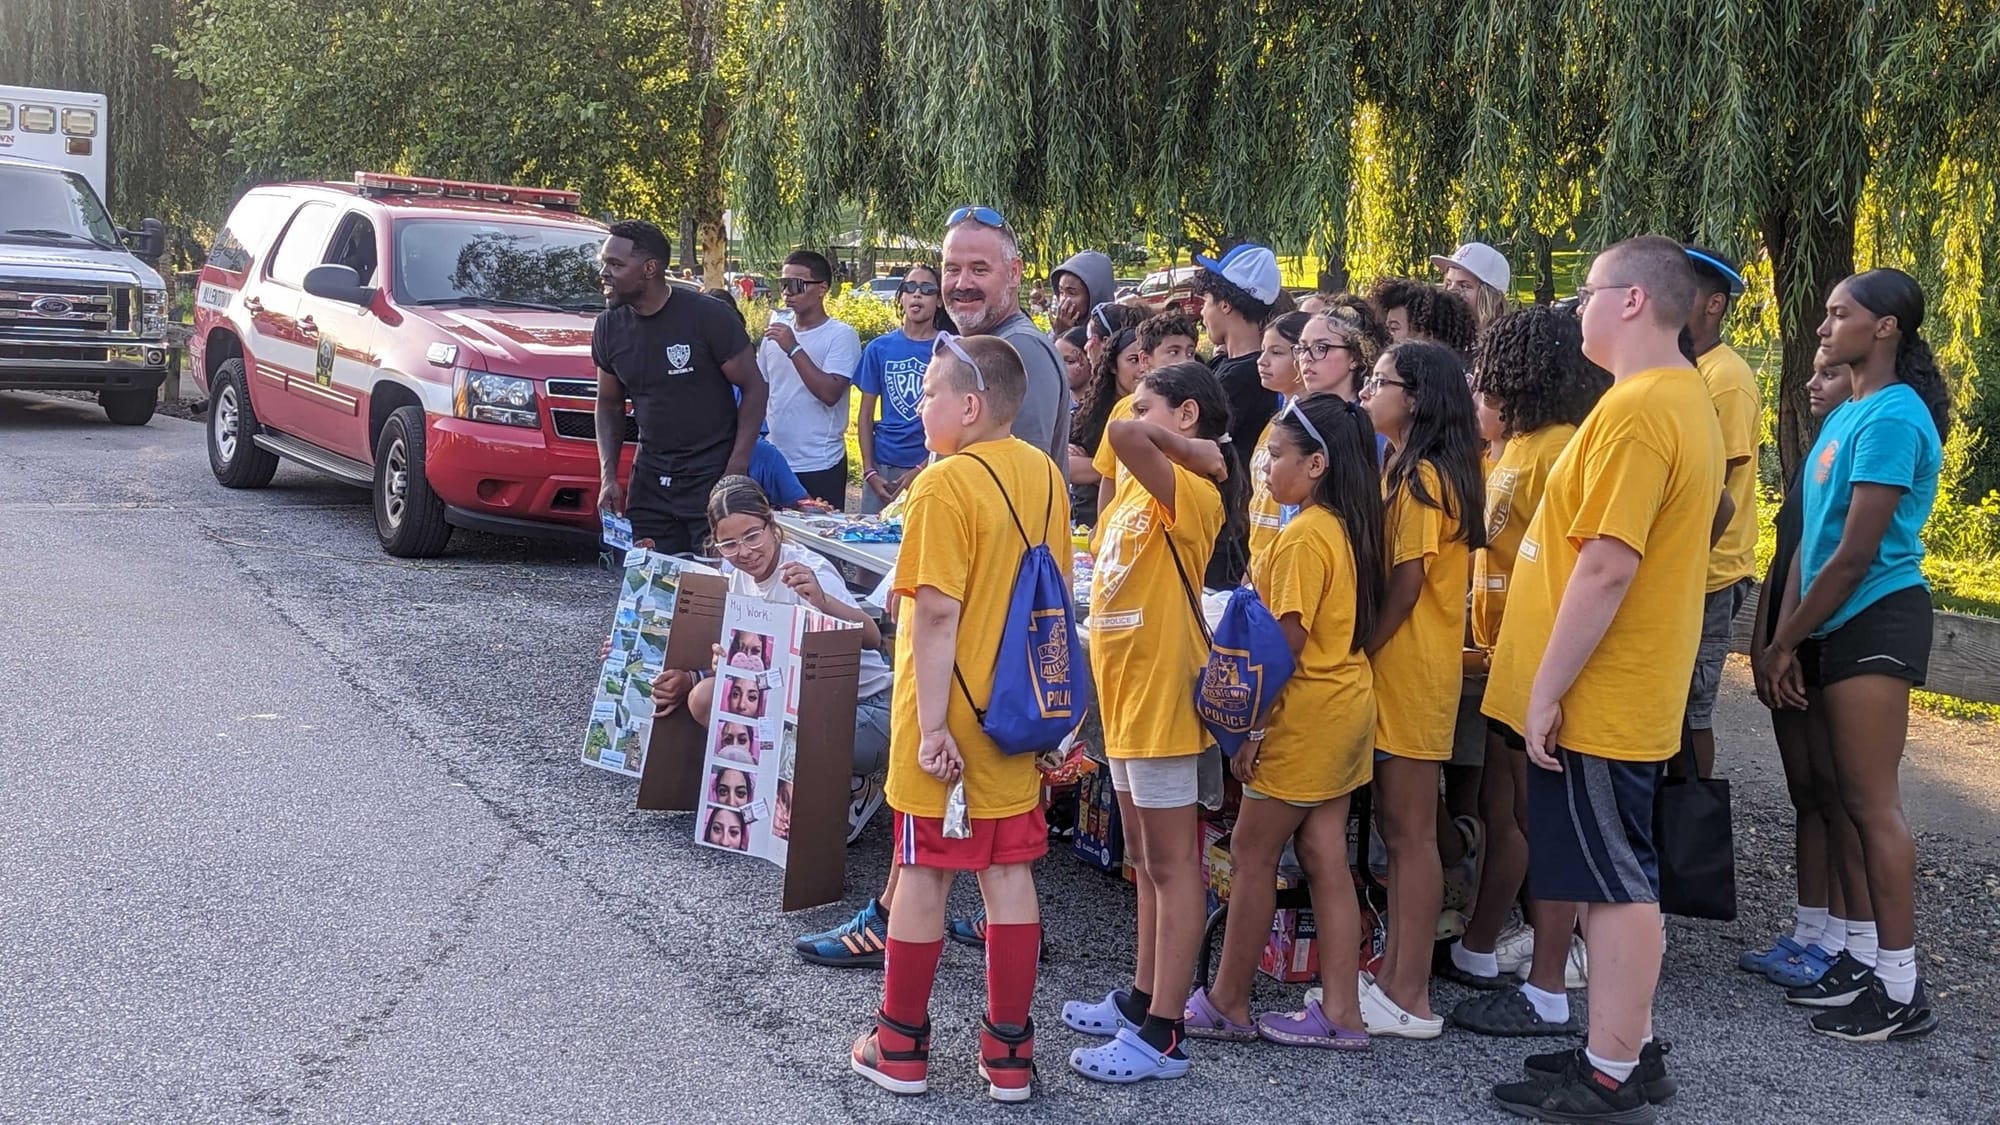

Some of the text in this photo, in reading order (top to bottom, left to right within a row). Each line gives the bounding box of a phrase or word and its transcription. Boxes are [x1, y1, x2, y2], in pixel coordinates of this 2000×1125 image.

[892, 362, 926, 373] POLIC
[886, 375, 909, 414] ATHLETIC
[1040, 646, 1057, 659] 1762
[1043, 654, 1070, 675] ALLENT
[1047, 690, 1071, 707] POLI
[1205, 706, 1248, 727] POLICE
